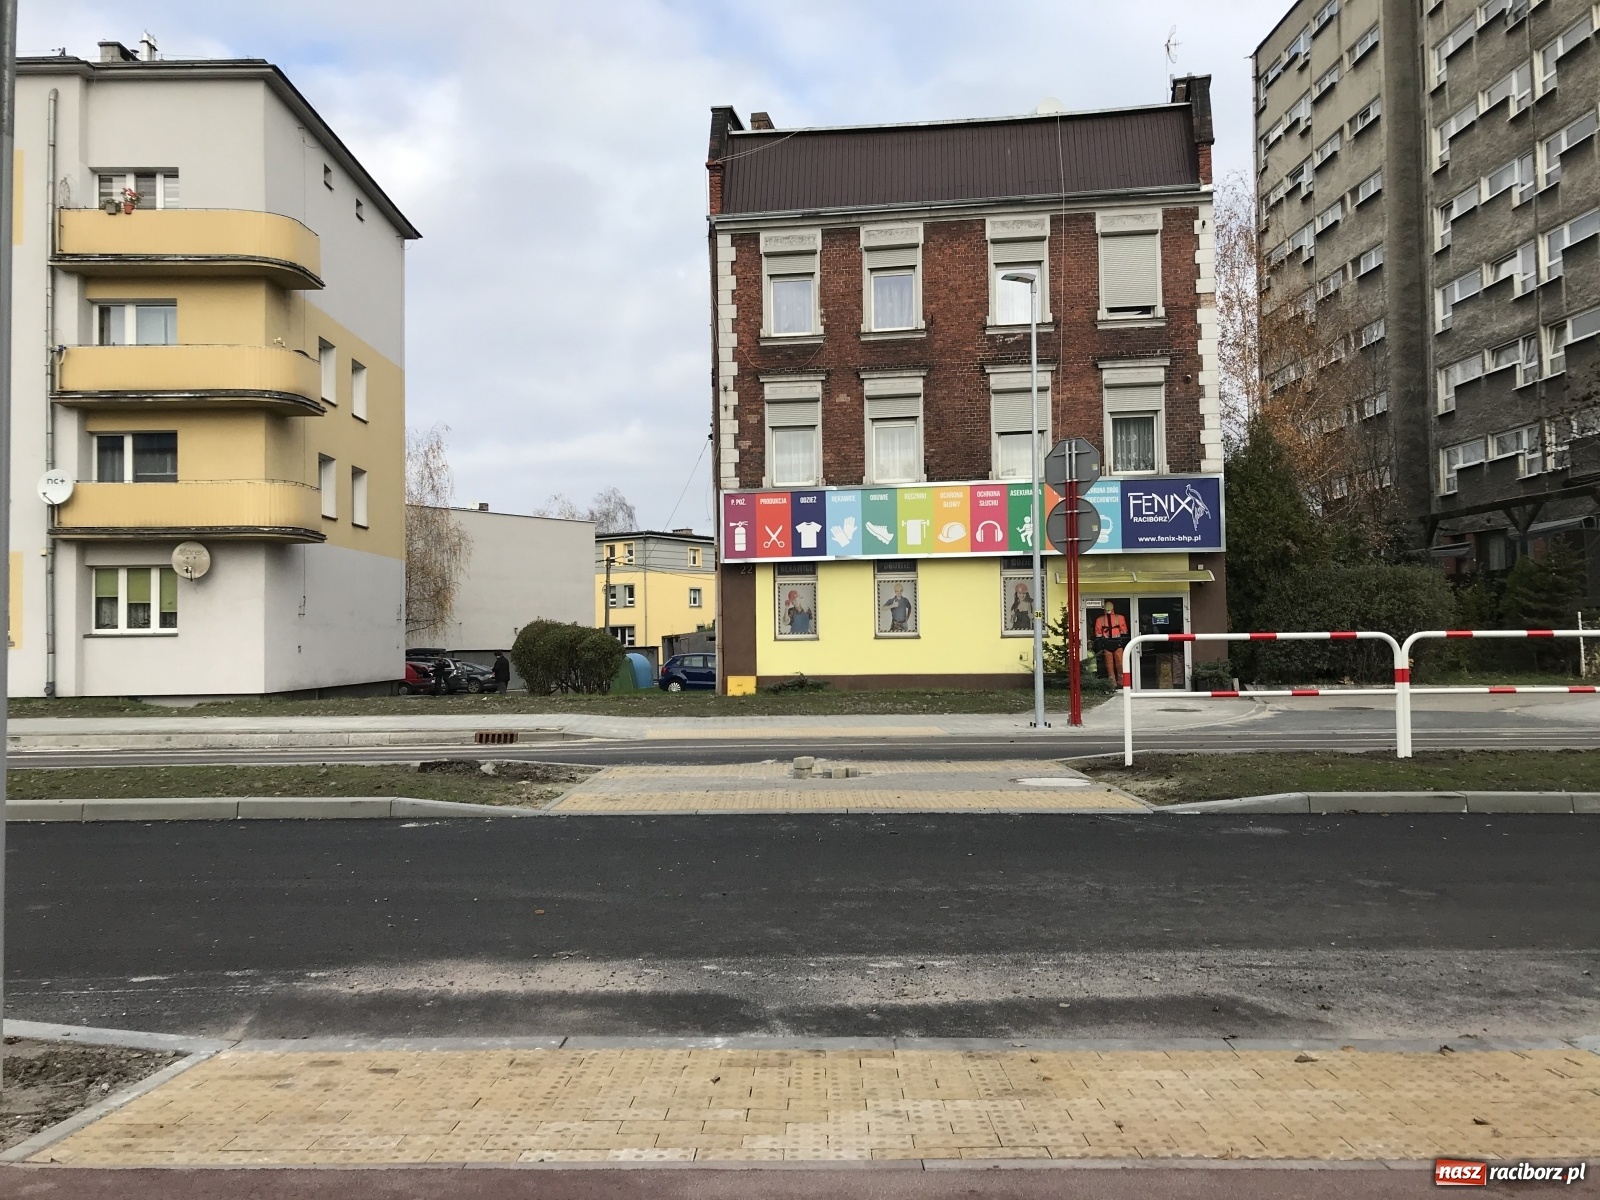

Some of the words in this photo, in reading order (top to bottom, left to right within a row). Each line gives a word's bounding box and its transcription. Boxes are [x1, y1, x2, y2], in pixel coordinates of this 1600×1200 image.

[940, 491, 963, 499] OCHRONA
[977, 490, 1001, 498] OCHRONA
[1010, 489, 1042, 497] ASEKURAA
[760, 497, 787, 505] PRODUKCJA
[799, 496, 817, 504] ODZIEŻ
[943, 500, 960, 508] GŁOWY
[979, 499, 999, 507] SŁUCHU
[1127, 492, 1193, 524] FENIX
[1133, 515, 1168, 523] RACIBÓRZ
[1138, 535, 1201, 543] www.fenix-bhp.pl
[740, 564, 753, 575] 22
